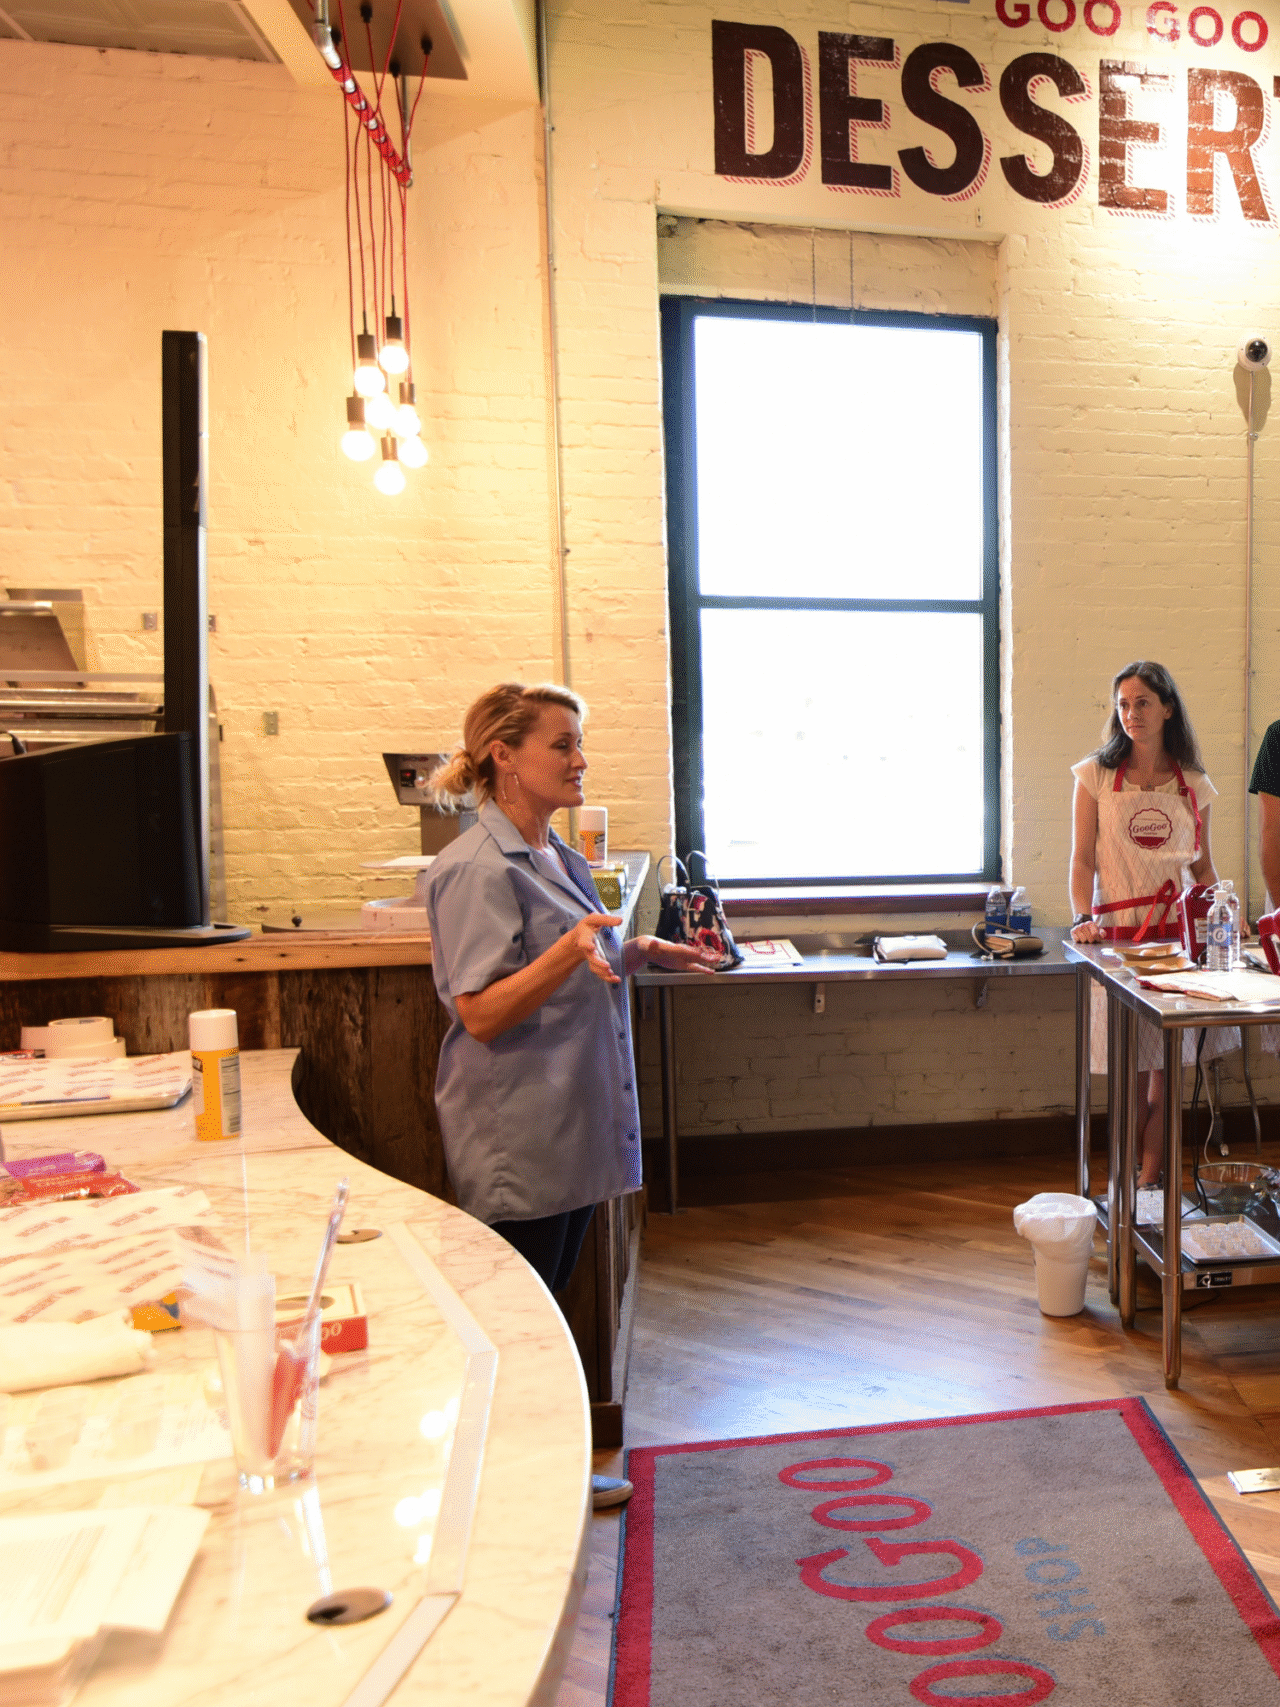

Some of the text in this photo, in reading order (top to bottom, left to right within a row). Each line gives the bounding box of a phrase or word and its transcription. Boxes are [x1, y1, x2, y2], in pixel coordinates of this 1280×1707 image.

[995, 0, 1121, 36] GOO
[1145, 0, 1269, 52] GOO
[1132, 823, 1168, 834] GooGoo
[1014, 1537, 1107, 1642] SHOP
